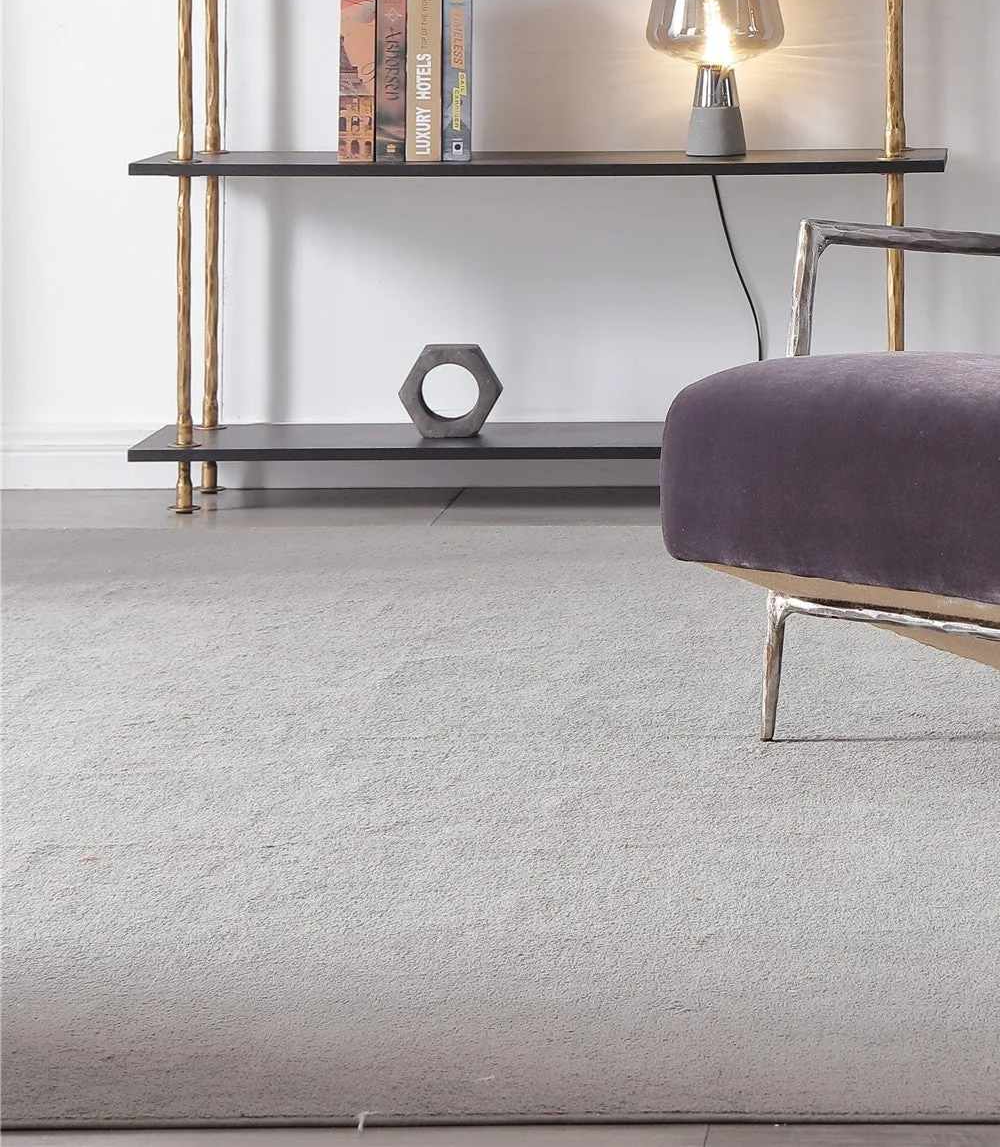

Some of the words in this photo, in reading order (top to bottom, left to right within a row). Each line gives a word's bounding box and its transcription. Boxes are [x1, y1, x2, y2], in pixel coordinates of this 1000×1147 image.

[421, 28, 428, 36] OF
[416, 53, 432, 100] HOTELS
[415, 106, 431, 155] LUXURY
